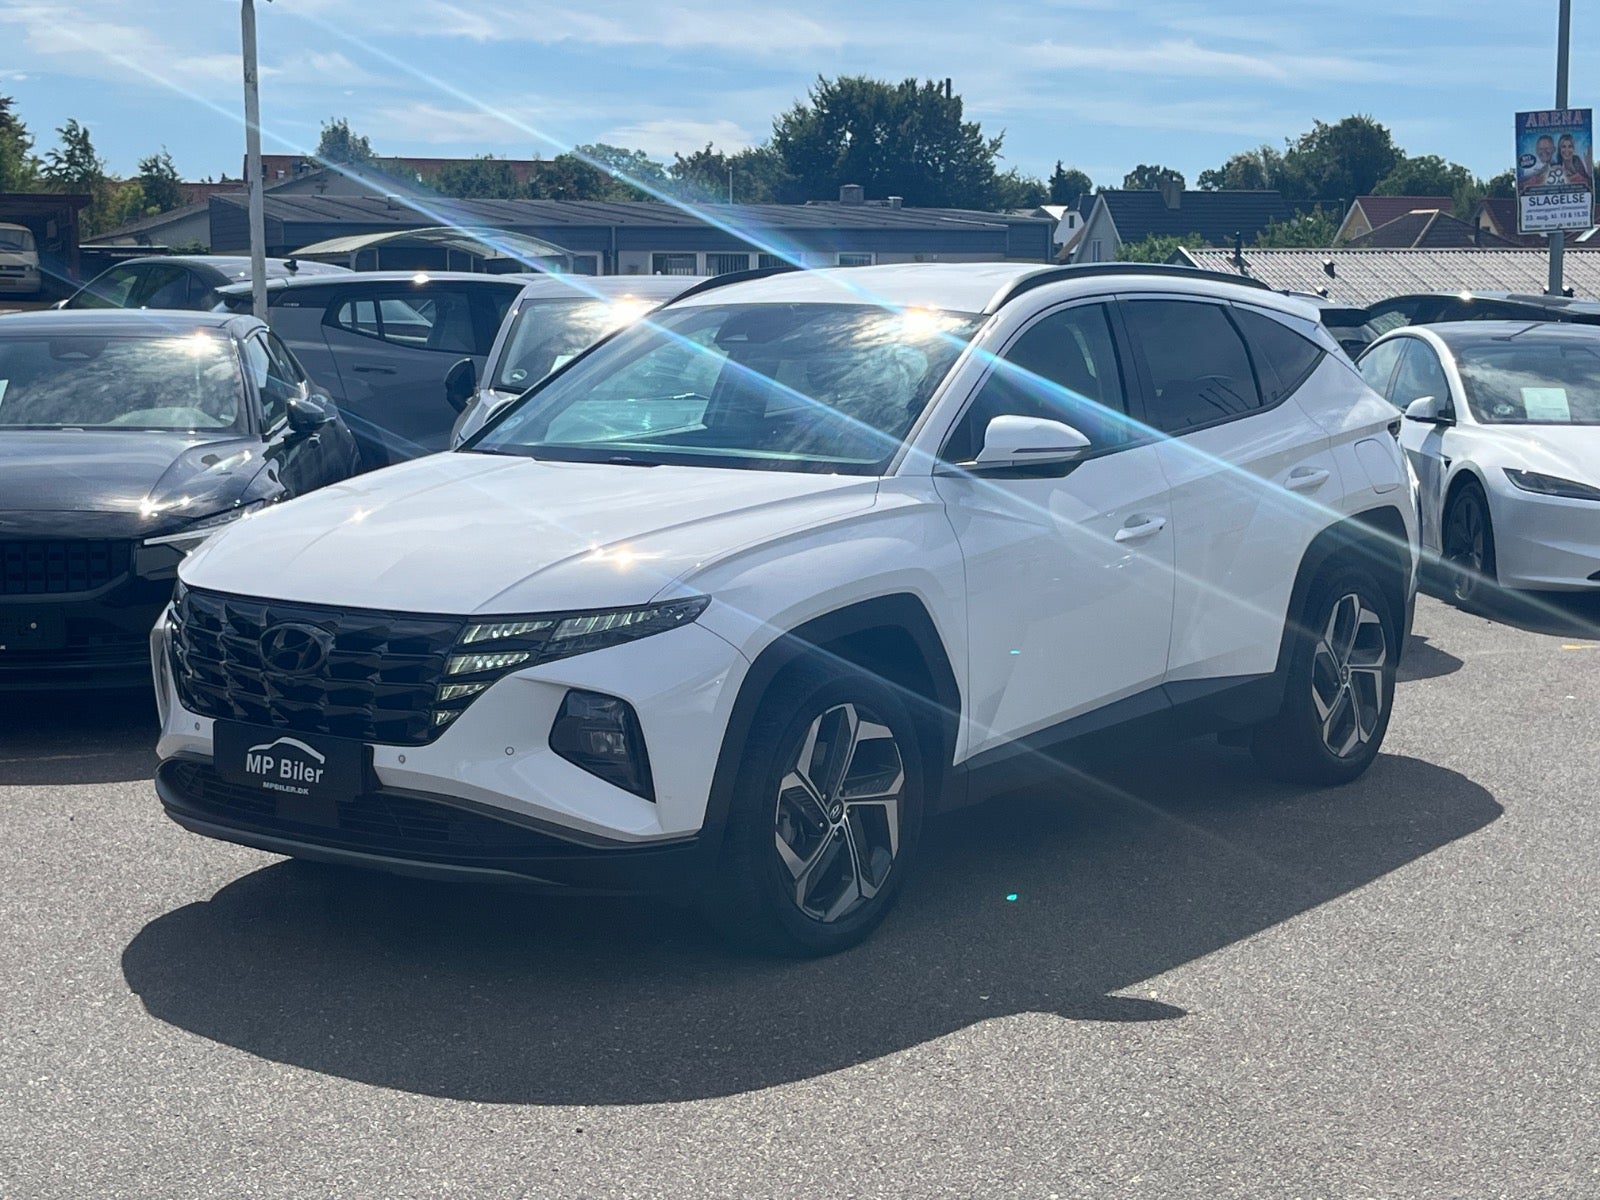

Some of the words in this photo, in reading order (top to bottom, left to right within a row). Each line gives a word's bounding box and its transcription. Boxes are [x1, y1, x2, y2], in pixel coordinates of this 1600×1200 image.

[1525, 111, 1583, 128] ARENA
[1528, 193, 1585, 207] SLAGELSE
[246, 753, 275, 775] MP
[280, 758, 324, 783] Biler
[262, 781, 309, 795] MPBILER.DK
